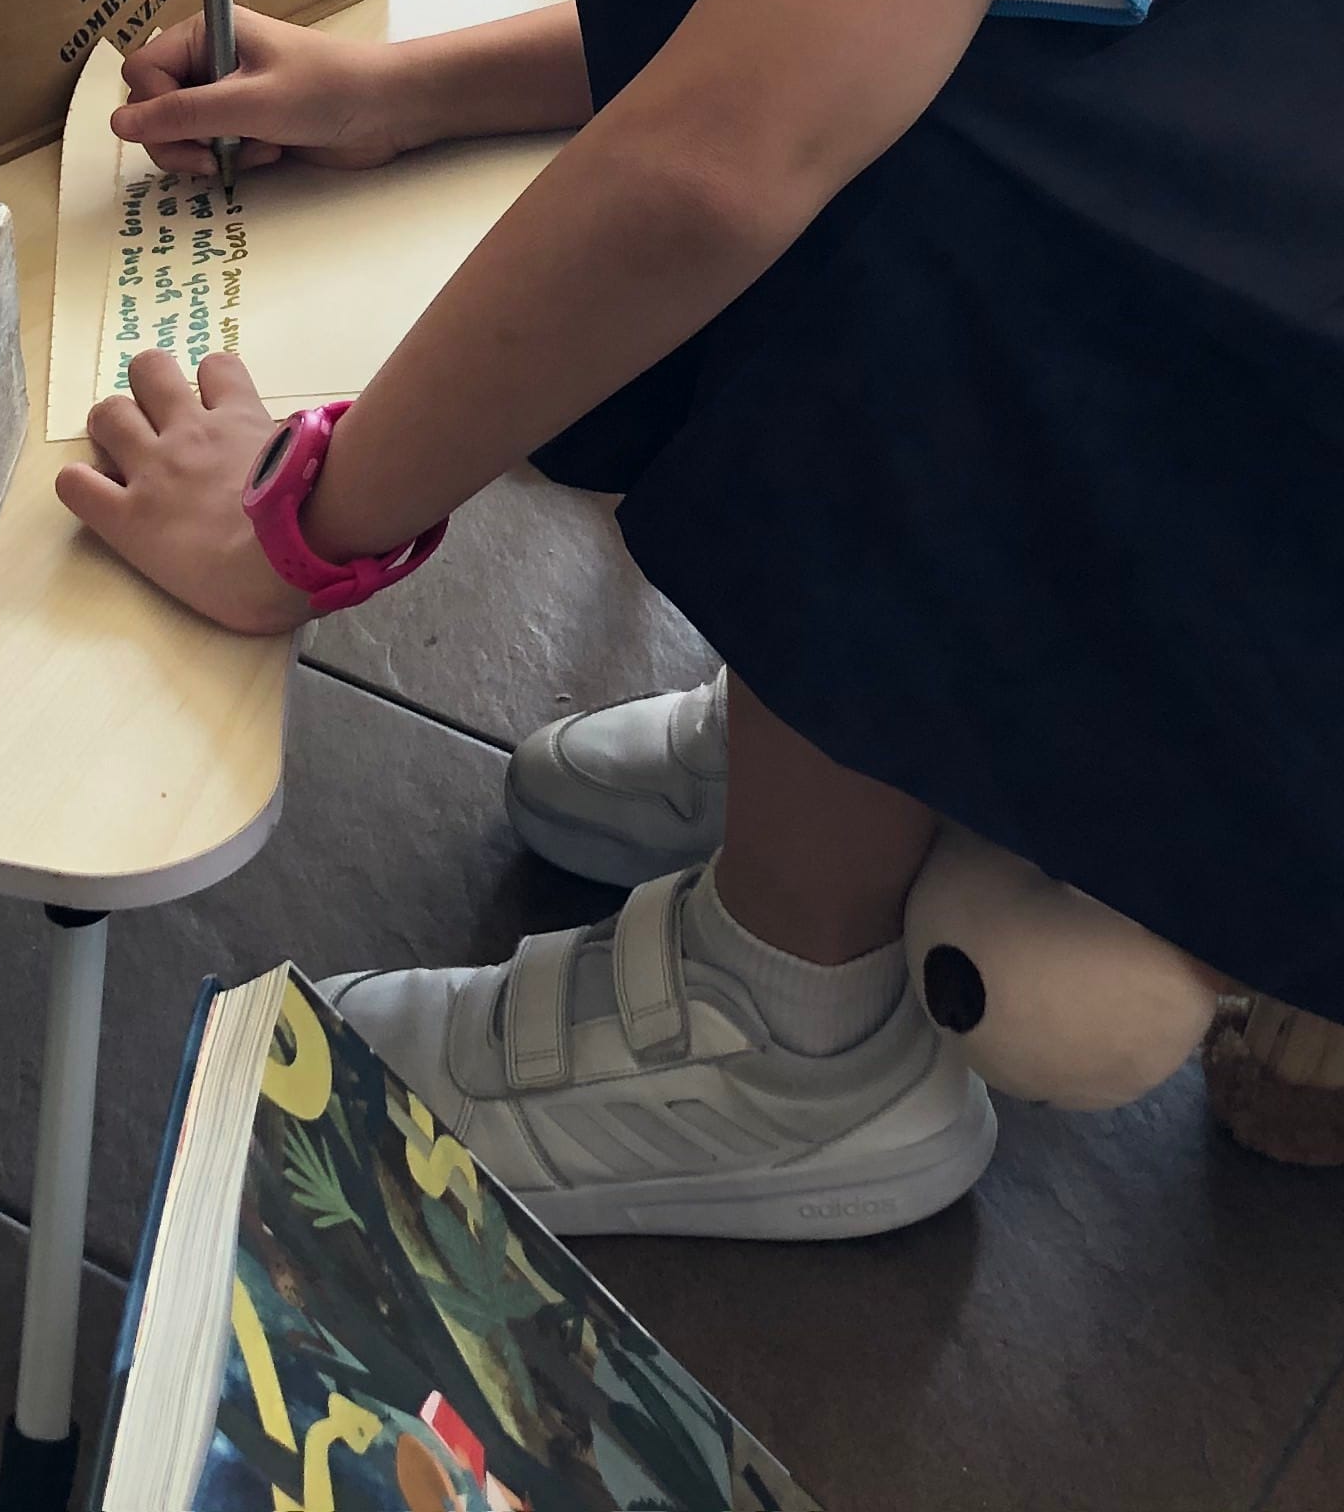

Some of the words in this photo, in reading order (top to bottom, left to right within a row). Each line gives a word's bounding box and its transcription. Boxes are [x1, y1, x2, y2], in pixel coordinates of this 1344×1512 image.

[157, 196, 178, 216] all
[152, 225, 176, 255] for
[191, 227, 227, 266] you
[222, 221, 249, 264] been
[154, 265, 183, 304] you
[218, 267, 243, 310] have
[115, 293, 140, 341] Doctor
[152, 312, 181, 358] ank
[181, 272, 210, 366] research
[798, 1196, 898, 1218] adidas
